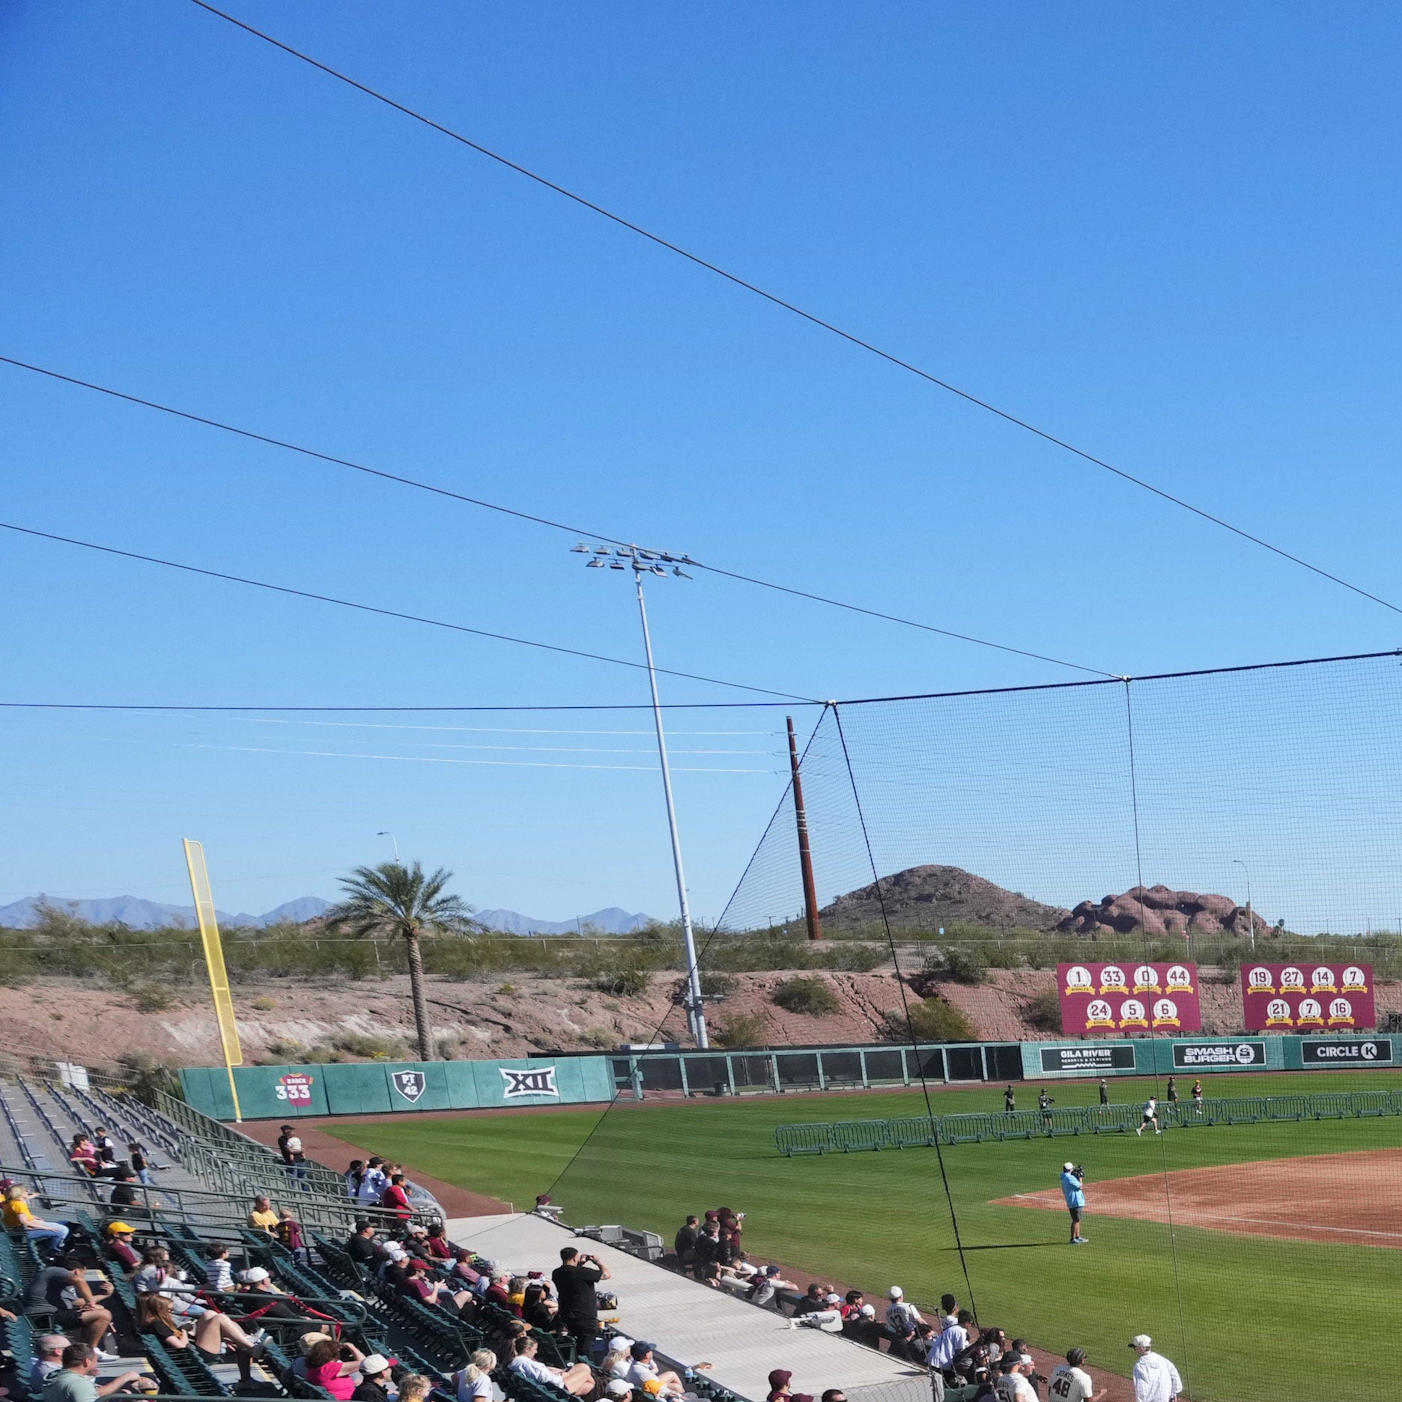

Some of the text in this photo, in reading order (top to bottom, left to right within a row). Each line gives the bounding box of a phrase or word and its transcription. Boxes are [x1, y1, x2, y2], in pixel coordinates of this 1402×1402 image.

[1075, 971, 1081, 982] 1
[1104, 971, 1120, 982] 33
[1170, 970, 1186, 981] 44
[1254, 971, 1266, 983] 19
[1284, 971, 1299, 982] 27
[1317, 971, 1328, 982] 14
[1350, 971, 1357, 981] 7
[1091, 1004, 1107, 1016] 24
[1129, 1004, 1137, 1015] 5
[1161, 1003, 1169, 1014] 6
[1272, 1003, 1285, 1015] 21
[1306, 1003, 1313, 1014] 7
[1334, 1002, 1346, 1013] 16
[1061, 1049, 1111, 1058] GILA RIVER
[1185, 1047, 1233, 1056] SMASH
[1317, 1042, 1378, 1059] CIRCLE K
[1184, 1054, 1236, 1063] BURGER
[401, 1074, 416, 1084] PT
[504, 1069, 556, 1095] XII
[275, 1084, 311, 1100] 333
[404, 1085, 418, 1096] 42
[1052, 1378, 1071, 1399] 48
